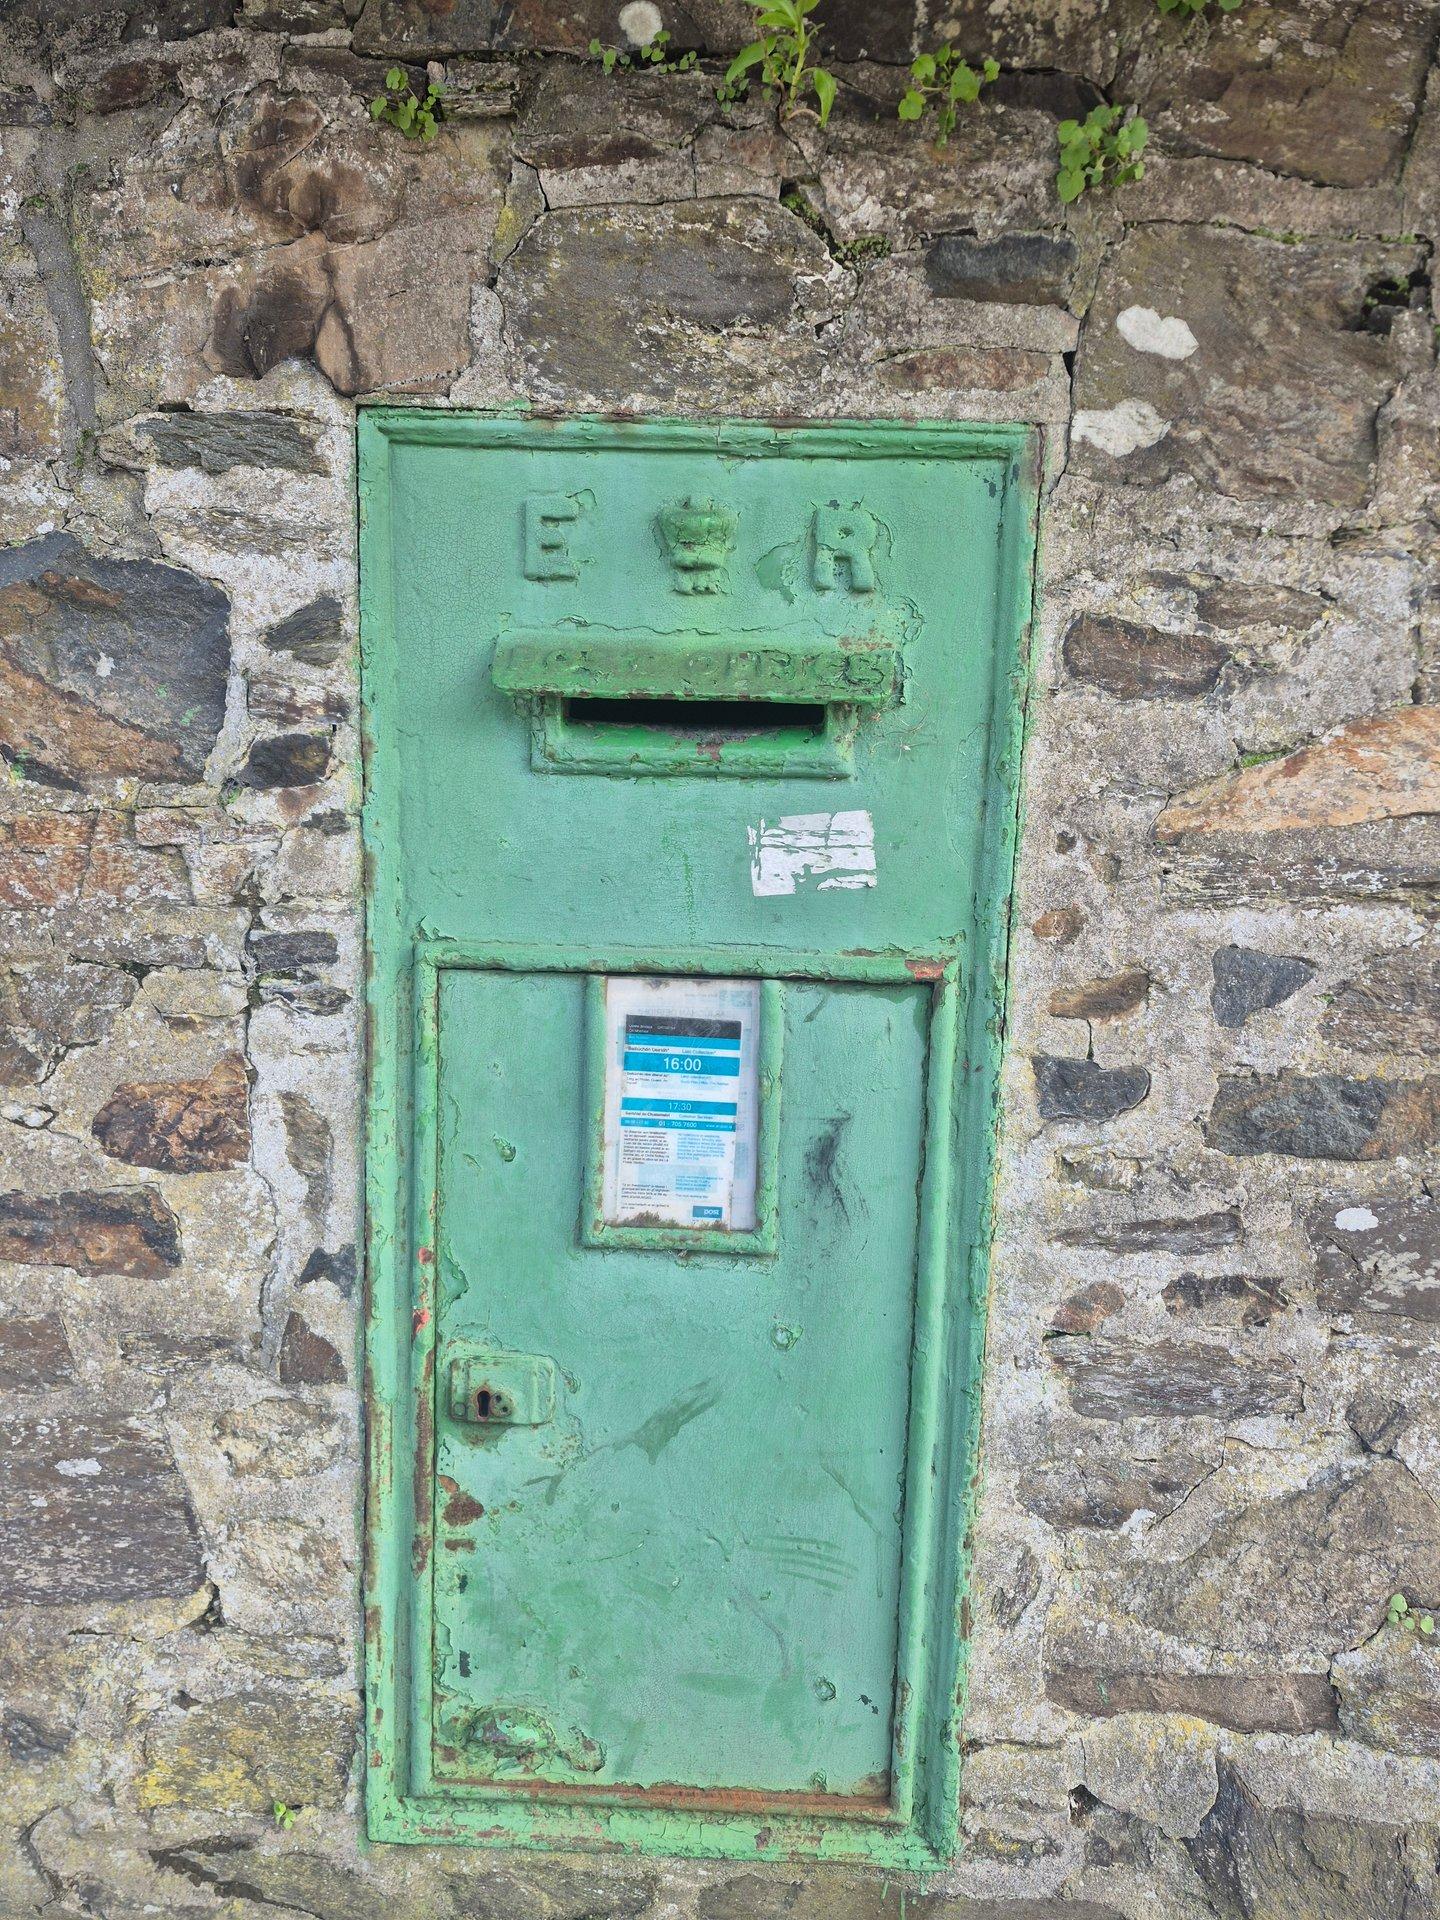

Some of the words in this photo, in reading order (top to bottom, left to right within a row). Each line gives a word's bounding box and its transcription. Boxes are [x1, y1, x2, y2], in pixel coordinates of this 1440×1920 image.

[523, 495, 579, 582] E
[811, 505, 879, 594] R
[663, 1056, 702, 1072] 16:00
[668, 1102, 692, 1111] 17:30
